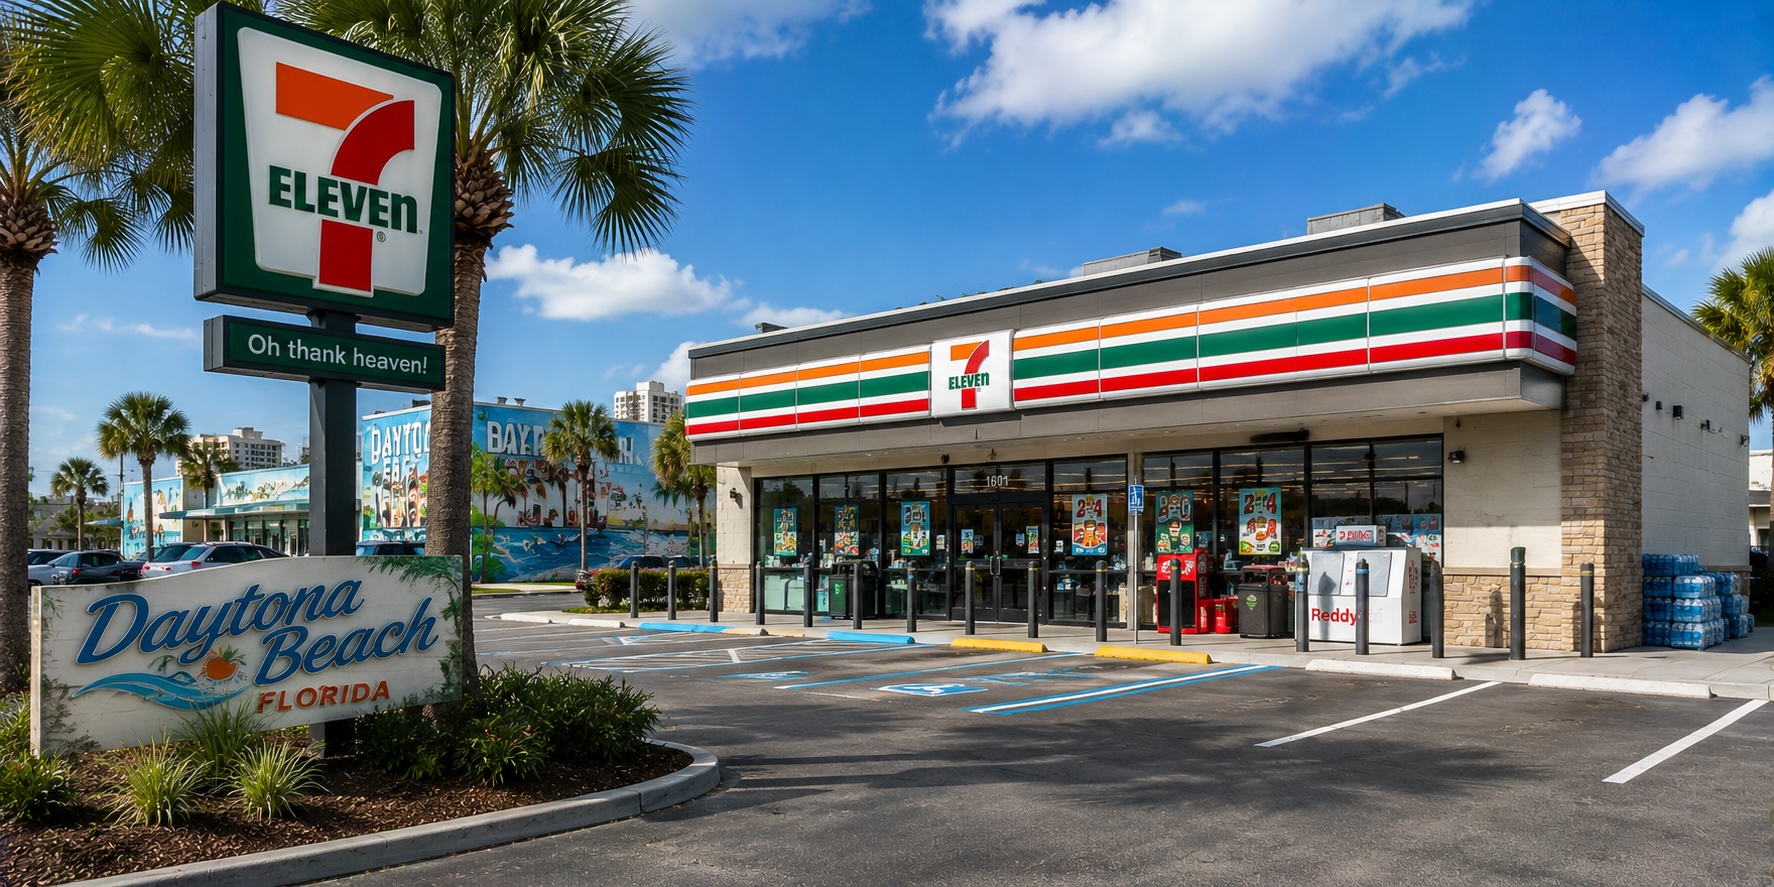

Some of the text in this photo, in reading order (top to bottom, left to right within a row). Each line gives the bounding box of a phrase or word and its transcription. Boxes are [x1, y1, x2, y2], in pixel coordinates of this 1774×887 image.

[276, 61, 415, 292] 7
[248, 333, 428, 375] Oh thank heaven!
[950, 339, 990, 411] 7
[986, 474, 1008, 487] 1601
[75, 579, 365, 665] Daytona
[253, 597, 440, 687] Beach
[1311, 607, 1357, 626] Reddy
[256, 680, 391, 714] FLORIDA
